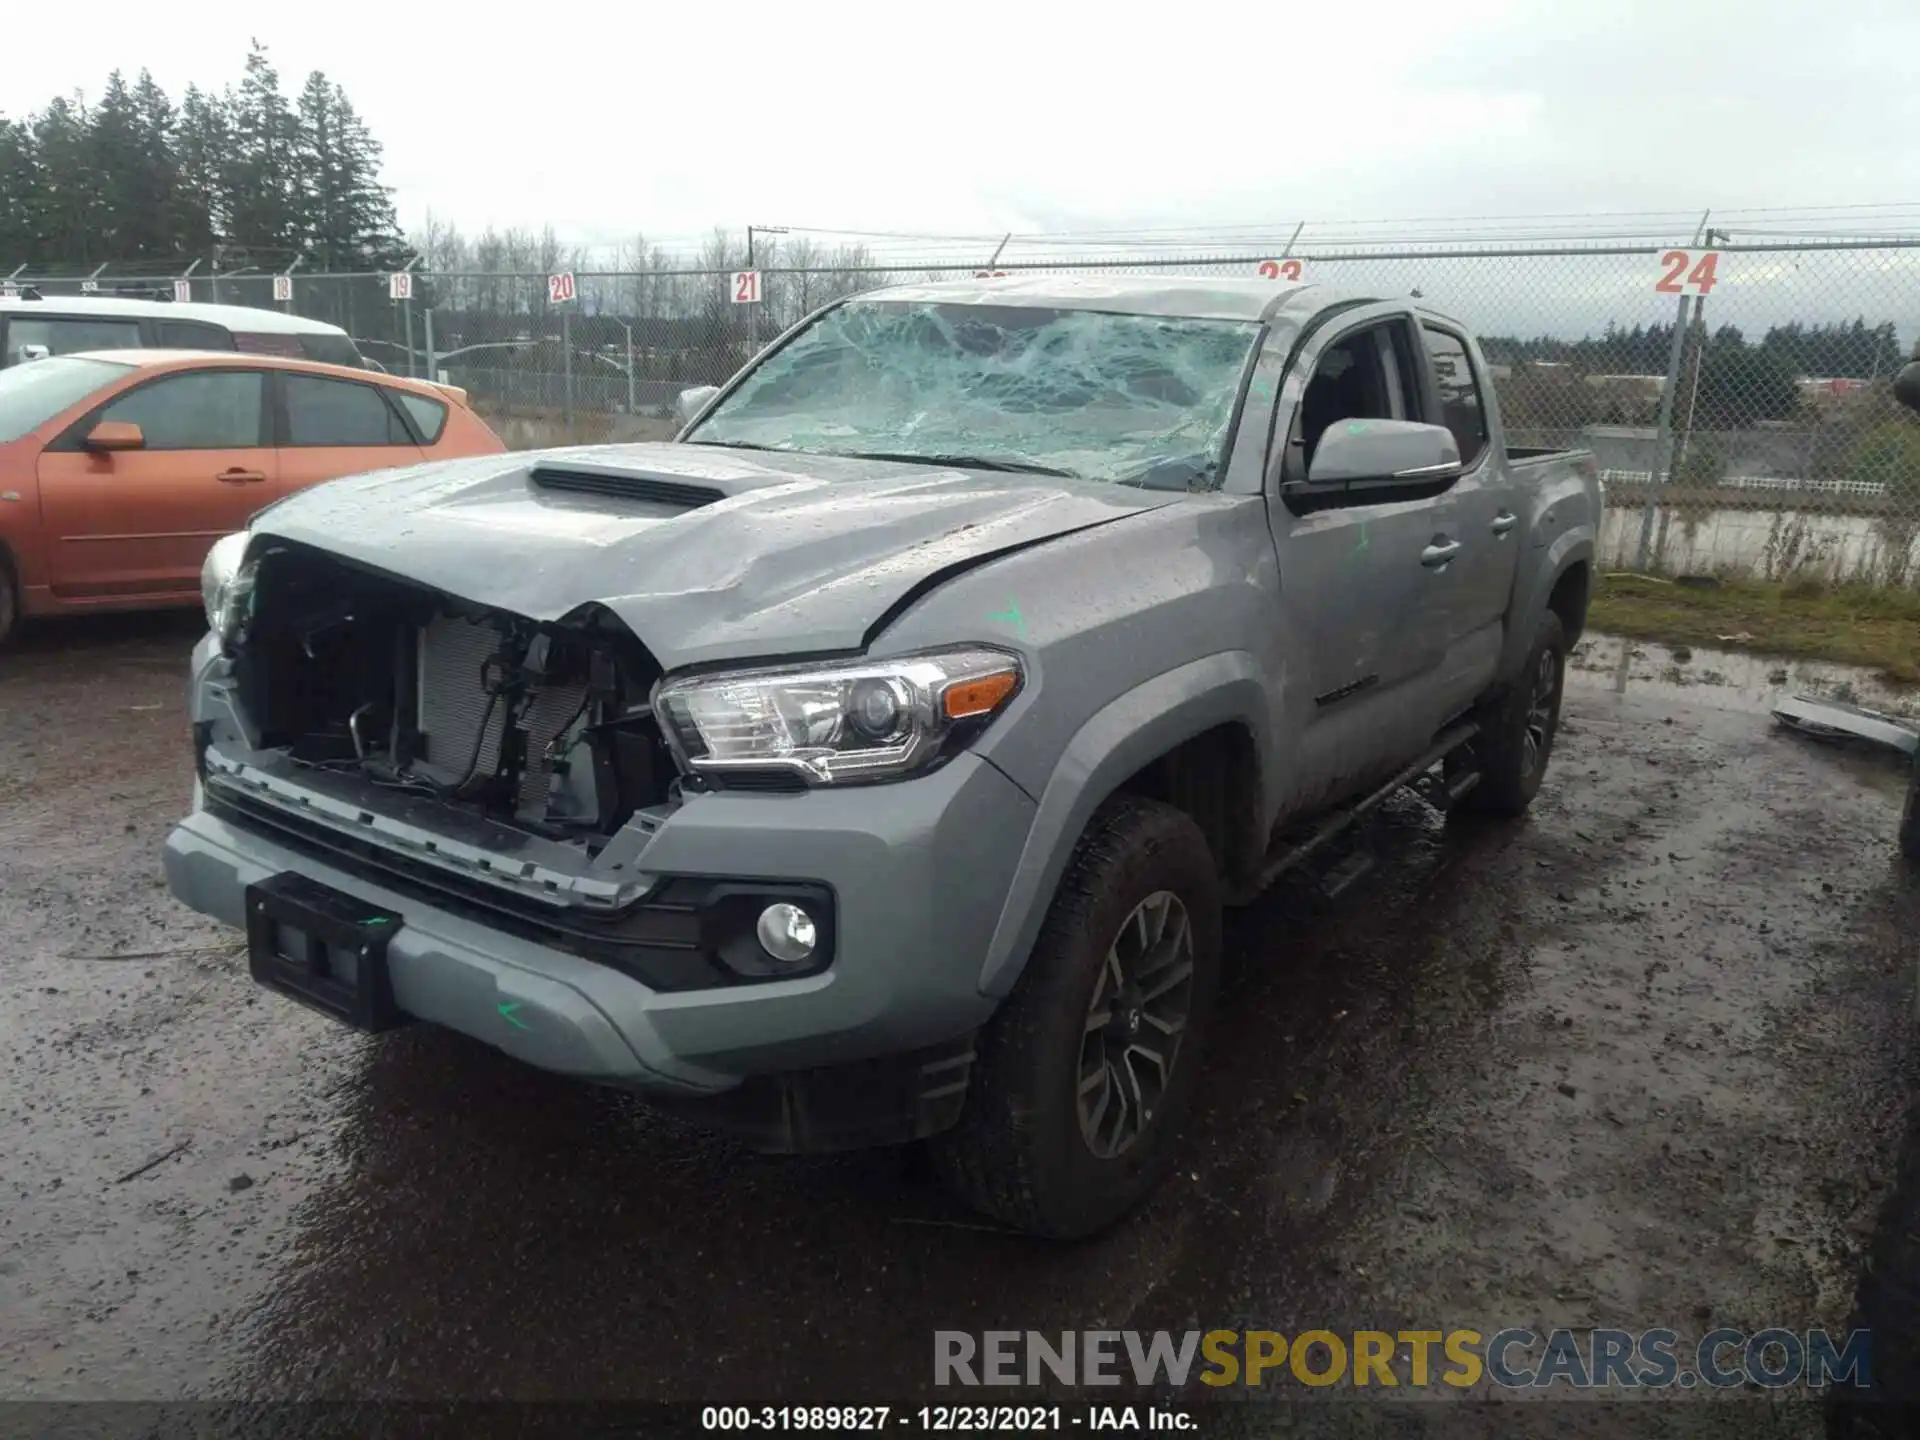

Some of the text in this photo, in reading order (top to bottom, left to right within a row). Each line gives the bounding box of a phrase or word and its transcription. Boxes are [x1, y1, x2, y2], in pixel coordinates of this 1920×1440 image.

[1655, 250, 1719, 294] 24
[394, 275, 408, 297] 19
[551, 274, 573, 300] 20
[736, 272, 756, 301] 21
